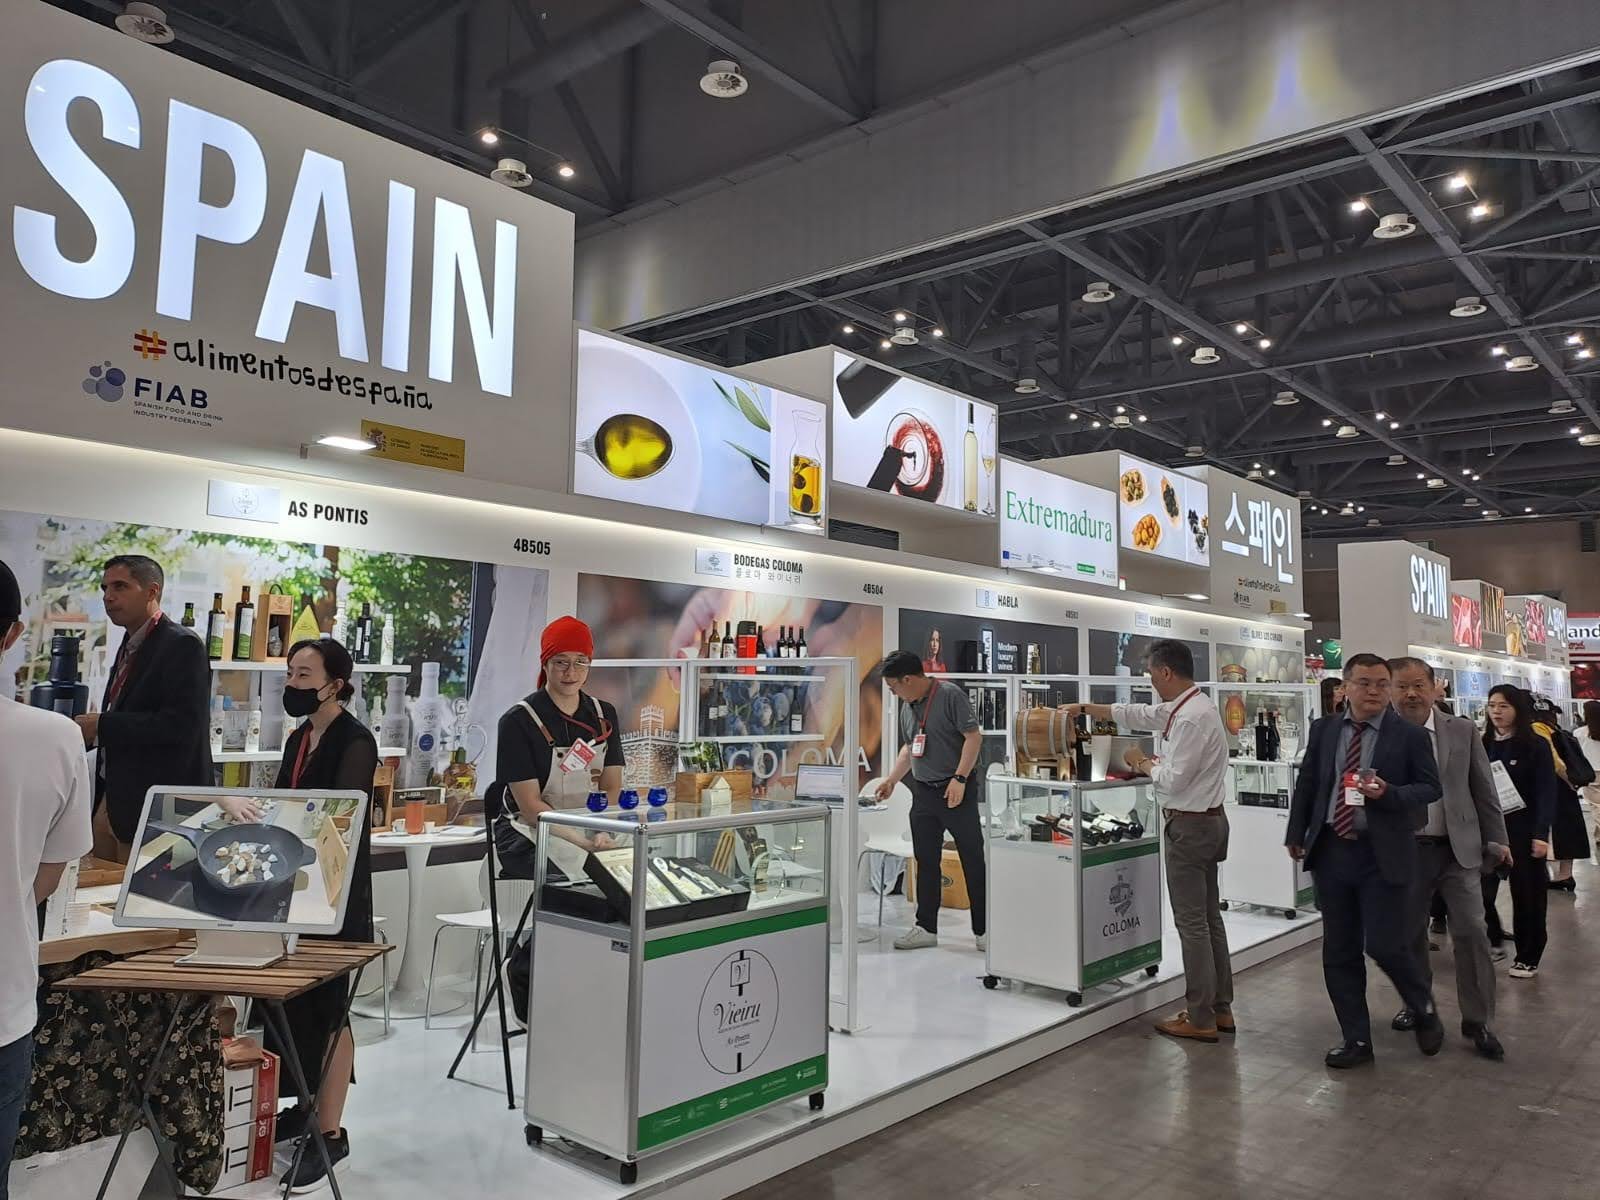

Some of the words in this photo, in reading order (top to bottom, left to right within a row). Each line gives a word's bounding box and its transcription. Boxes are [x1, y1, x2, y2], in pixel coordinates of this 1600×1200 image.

[13, 58, 518, 397] SPAIN
[134, 377, 208, 409] FIAB
[133, 409, 167, 419] INDUSTRY
[170, 416, 211, 426] FEDERATION
[134, 401, 163, 410] SPANISH
[165, 406, 185, 414] FOOD
[288, 500, 308, 517] AS
[313, 504, 369, 525] PONTIS
[1007, 490, 1112, 542] Extremadura
[513, 538, 551, 555] 4B505
[1222, 492, 1293, 584] 스페인
[734, 553, 770, 570] BODEGAS
[772, 559, 803, 574] COLOMA
[863, 583, 884, 595] 4B504
[1410, 554, 1448, 619] SPAIN
[998, 594, 1019, 608] HABLA
[997, 642, 1018, 652] Modern
[1102, 916, 1141, 937] COLOMA
[713, 1000, 761, 1030] Vieiru
